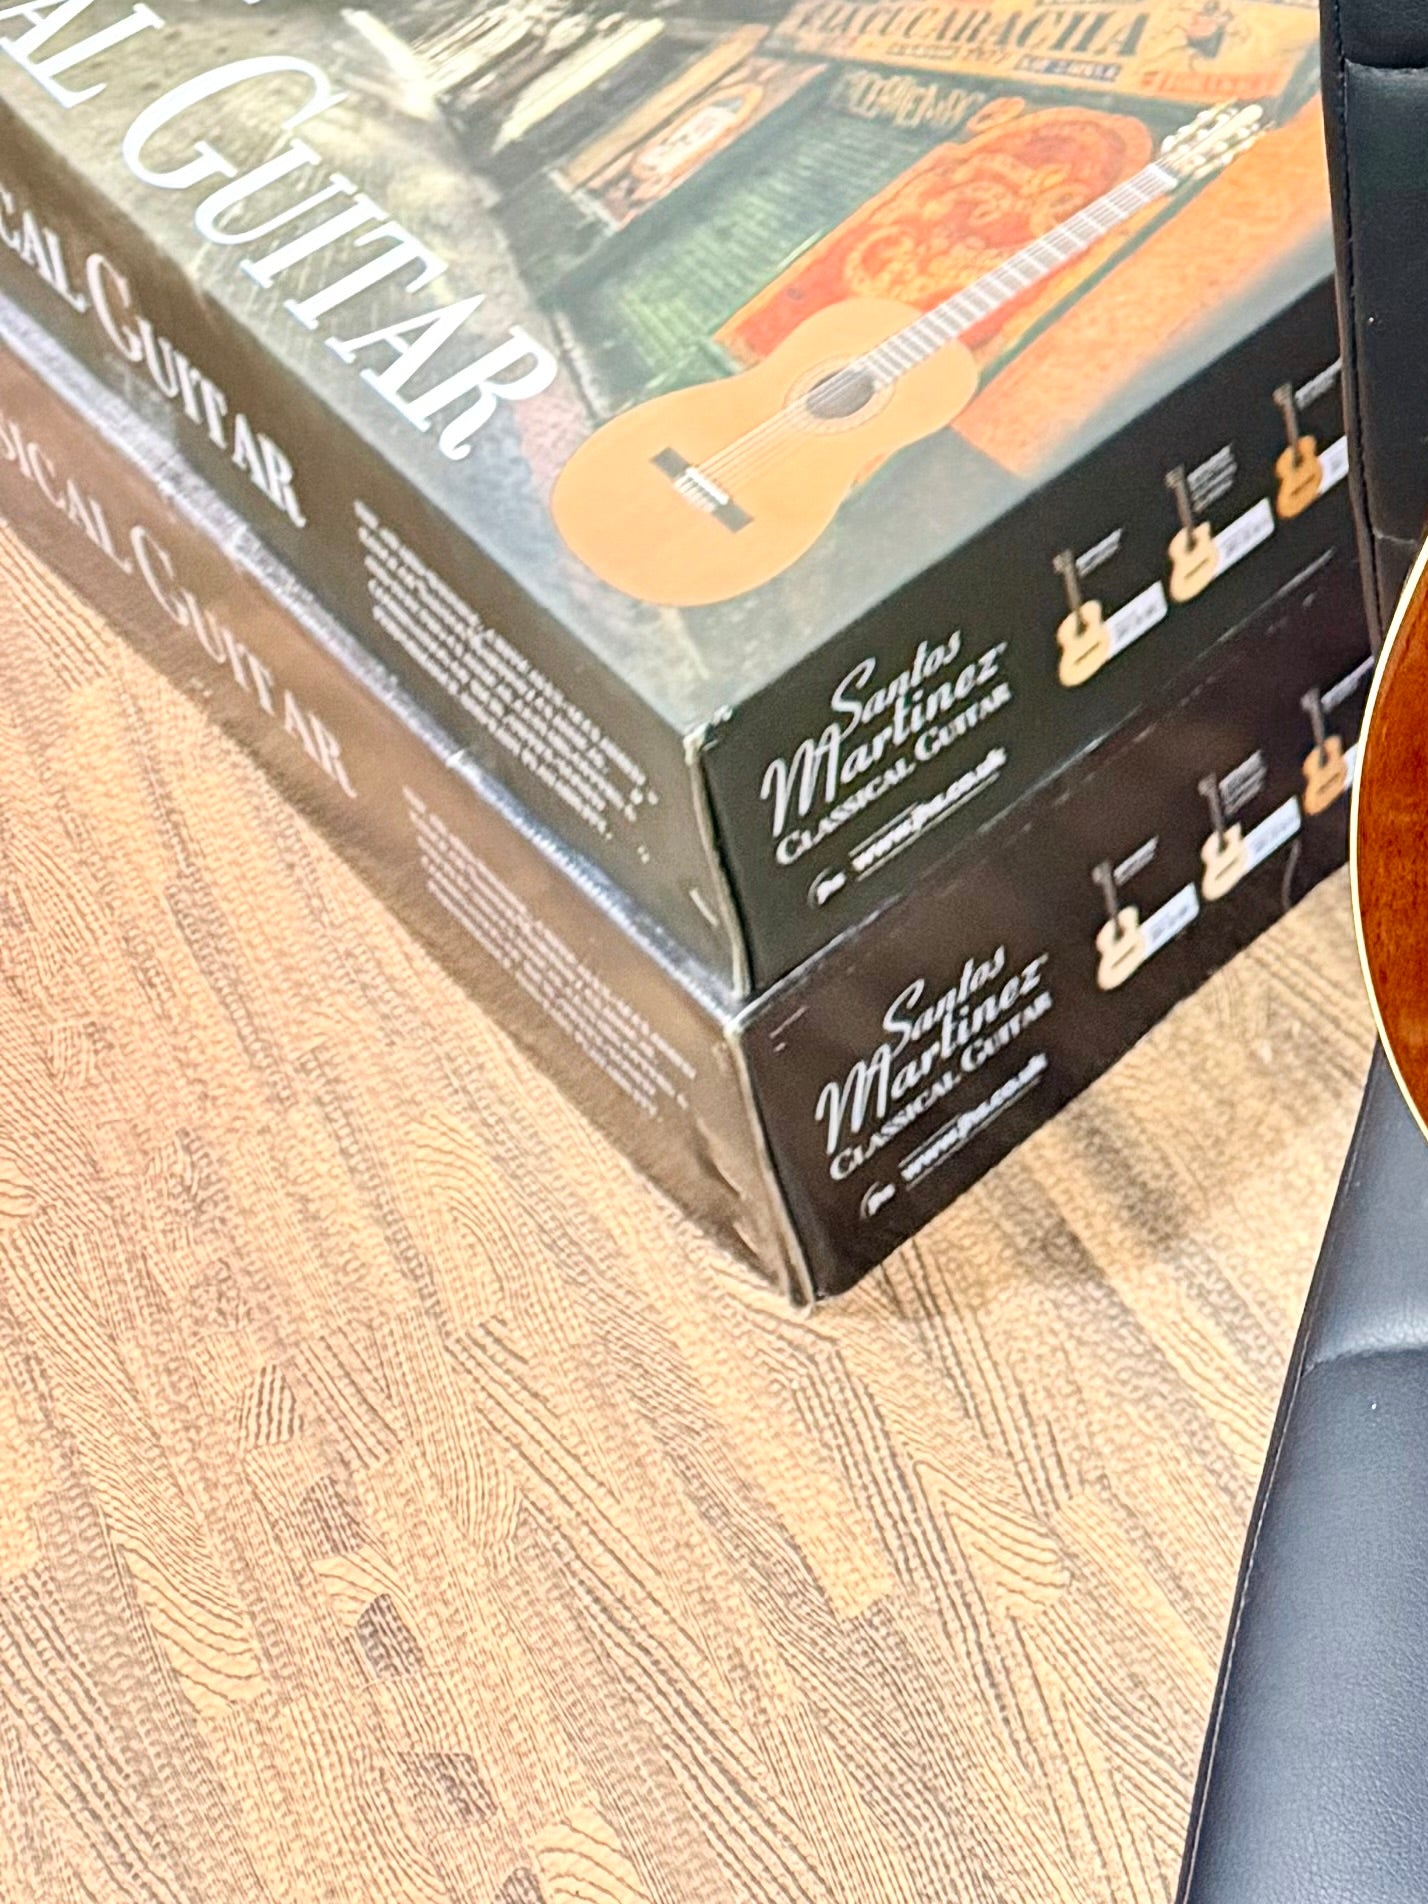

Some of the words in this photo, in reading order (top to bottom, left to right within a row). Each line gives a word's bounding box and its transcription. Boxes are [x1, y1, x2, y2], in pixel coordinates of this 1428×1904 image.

[121, 54, 560, 463] GUITAR
[85, 252, 306, 528] GUITAR
[130, 525, 357, 799] GUITAR
[760, 642, 1006, 838] Martinez
[831, 628, 962, 740] Santos
[814, 953, 1048, 1156] Martinez
[881, 944, 1006, 1059] Santos
